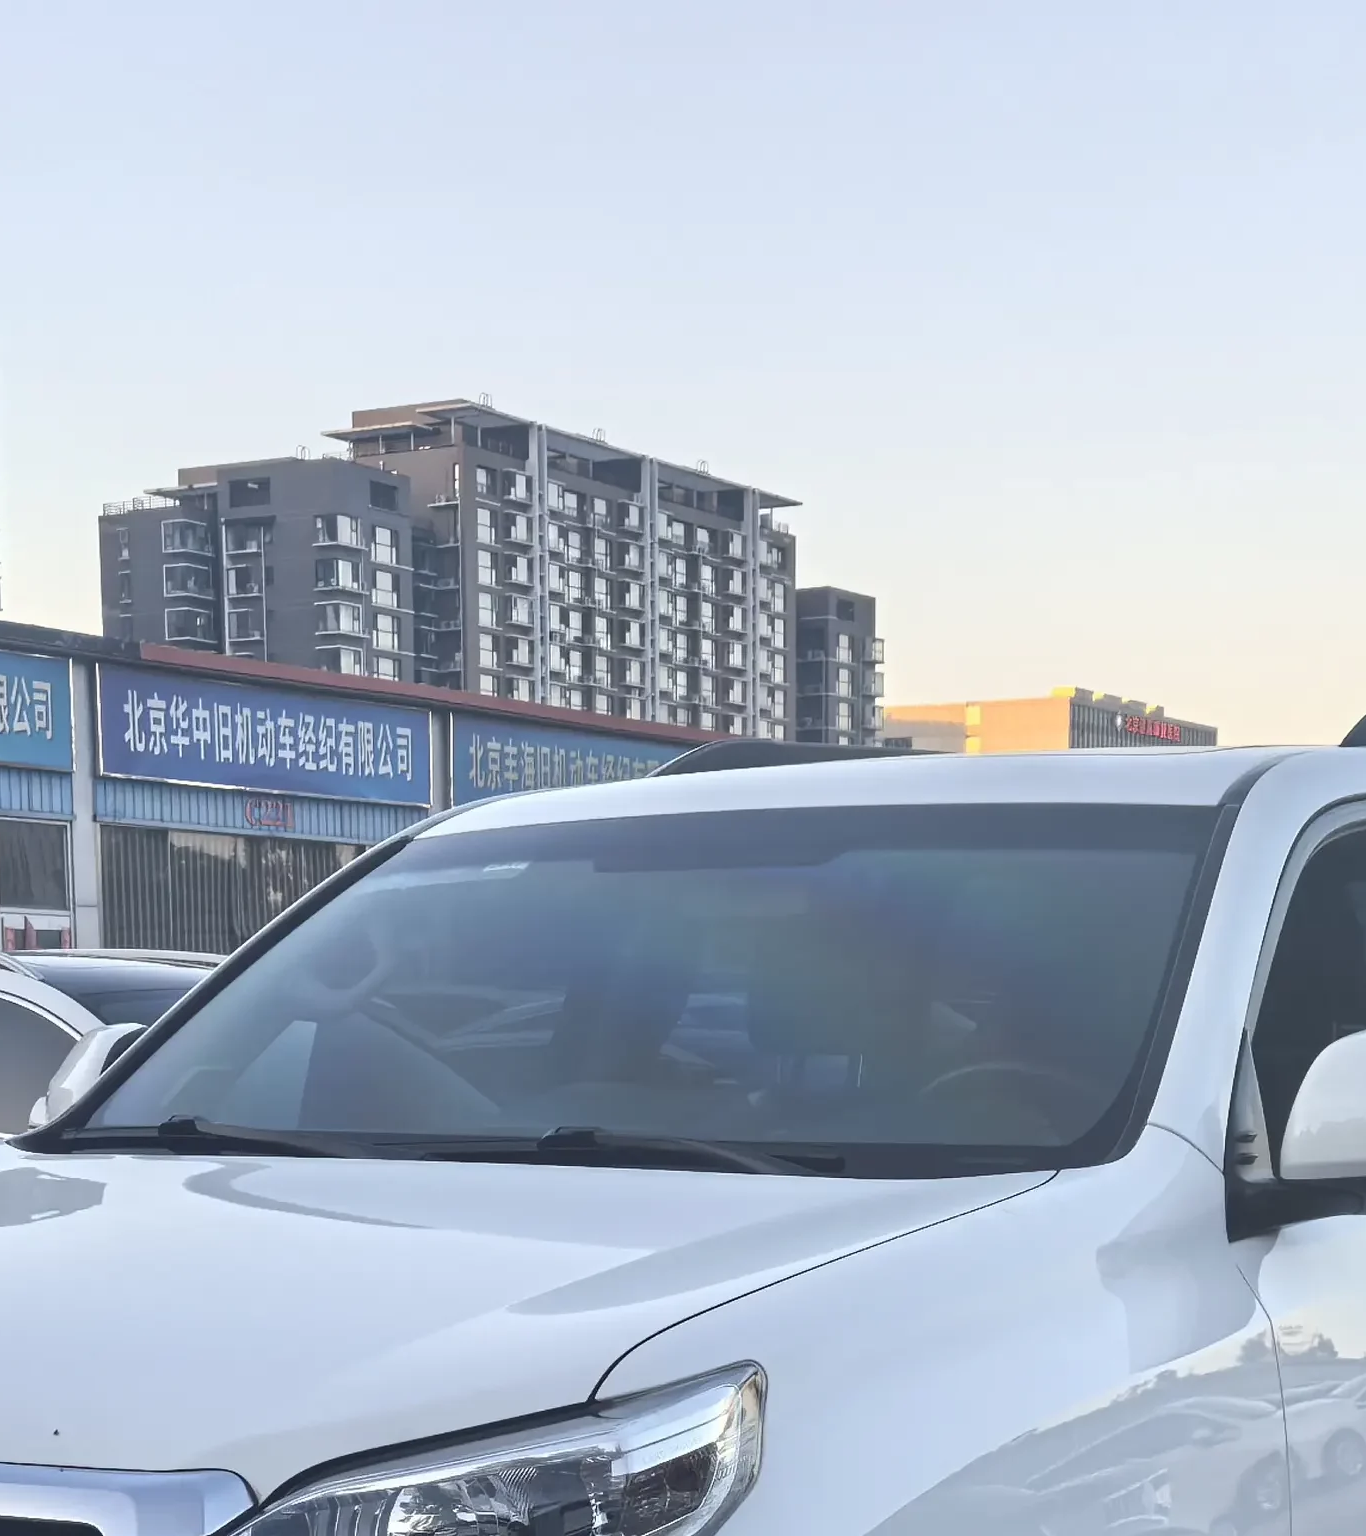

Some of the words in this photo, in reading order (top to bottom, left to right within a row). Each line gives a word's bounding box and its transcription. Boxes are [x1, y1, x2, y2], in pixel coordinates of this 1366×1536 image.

[123, 689, 413, 782] 北京华中旧机动车经纪有限公司
[244, 799, 295, 830] C221
